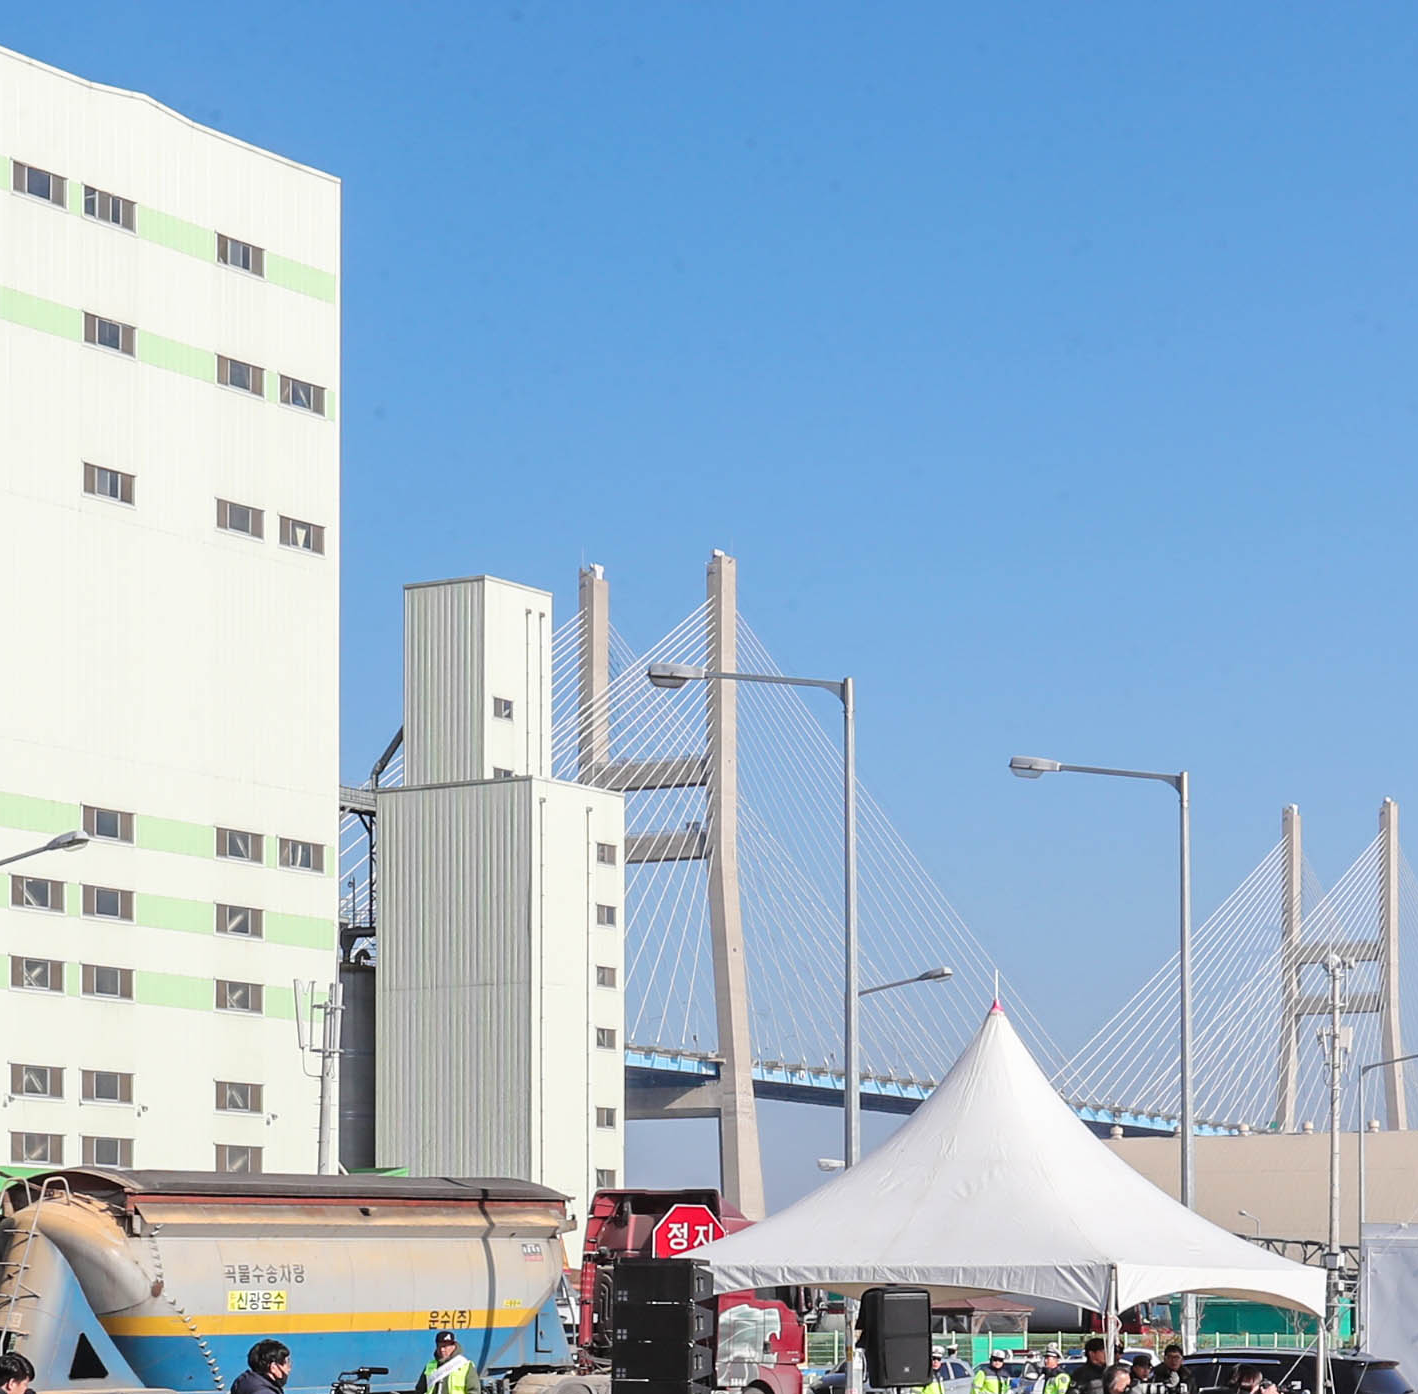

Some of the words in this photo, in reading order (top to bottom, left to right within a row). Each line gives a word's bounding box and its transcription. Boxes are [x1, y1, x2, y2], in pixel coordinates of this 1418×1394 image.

[666, 1221, 715, 1252] 정지
[224, 1264, 306, 1286] 곡물수송차량
[236, 1291, 285, 1312] 신광운수
[428, 1310, 472, 1330] 운수(주)
